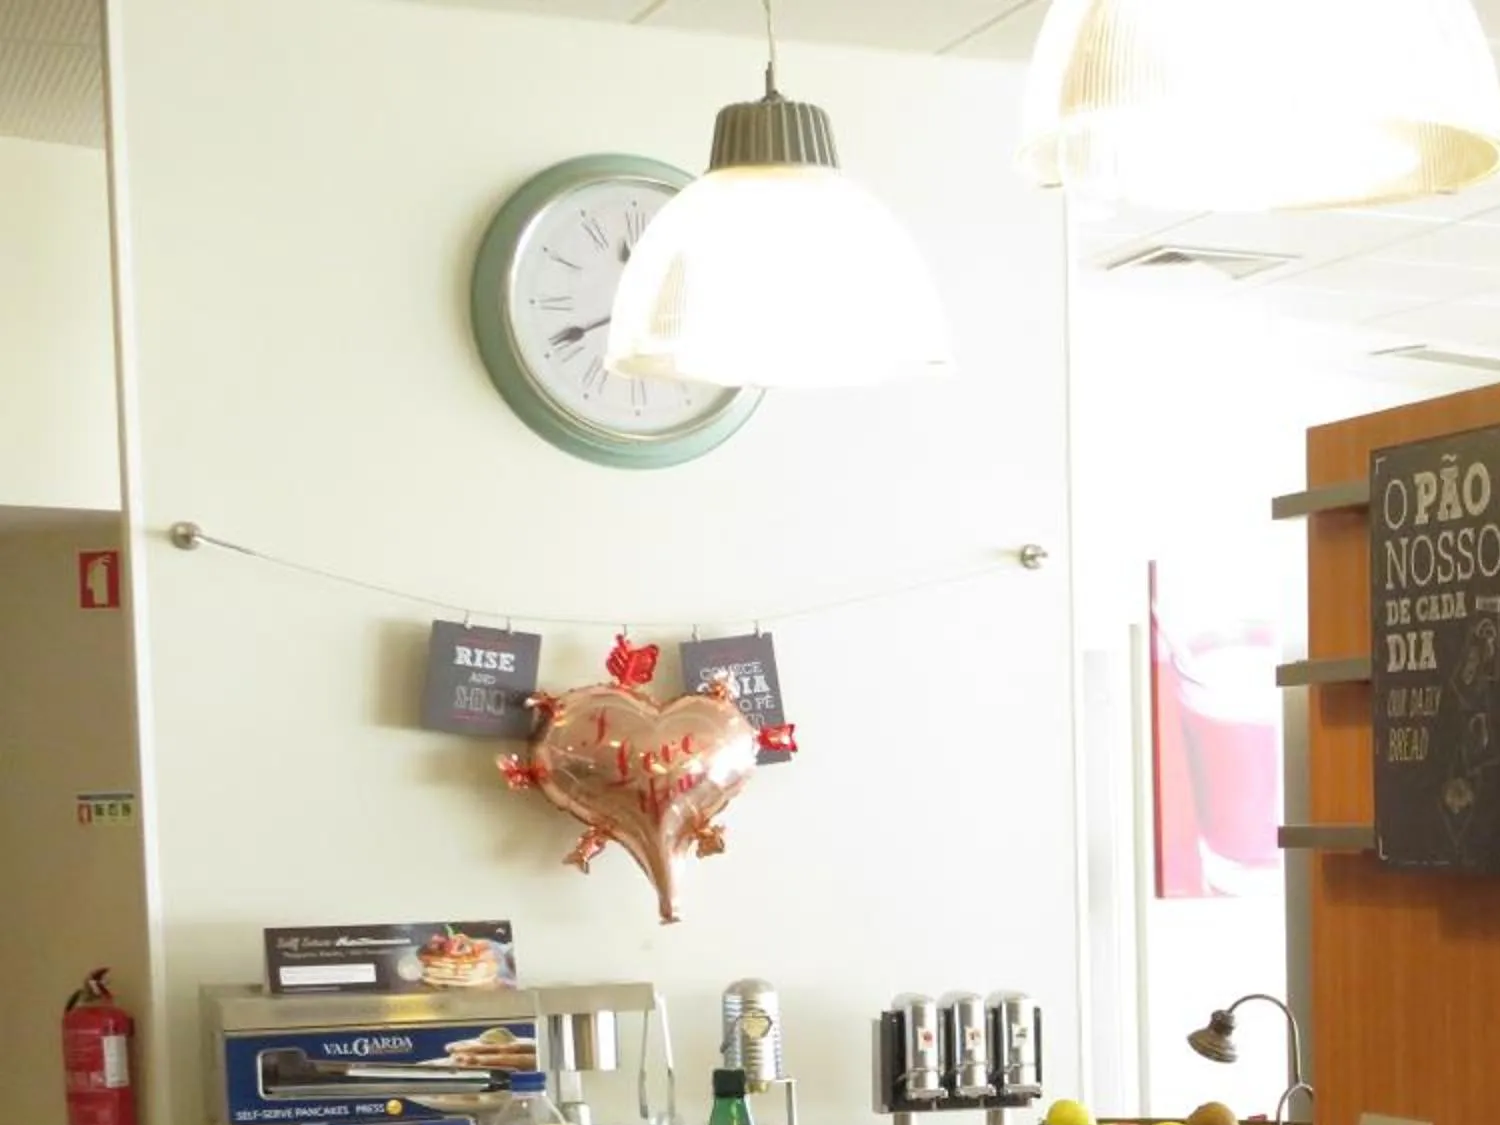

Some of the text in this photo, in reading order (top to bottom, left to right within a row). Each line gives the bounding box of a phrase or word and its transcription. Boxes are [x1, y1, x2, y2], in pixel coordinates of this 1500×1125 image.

[1383, 453, 1492, 530] O PÃO
[1385, 591, 1468, 627] DE CADA
[453, 645, 516, 672] RISE
[1386, 629, 1438, 673] DIA
[1388, 726, 1429, 763] BREAD
